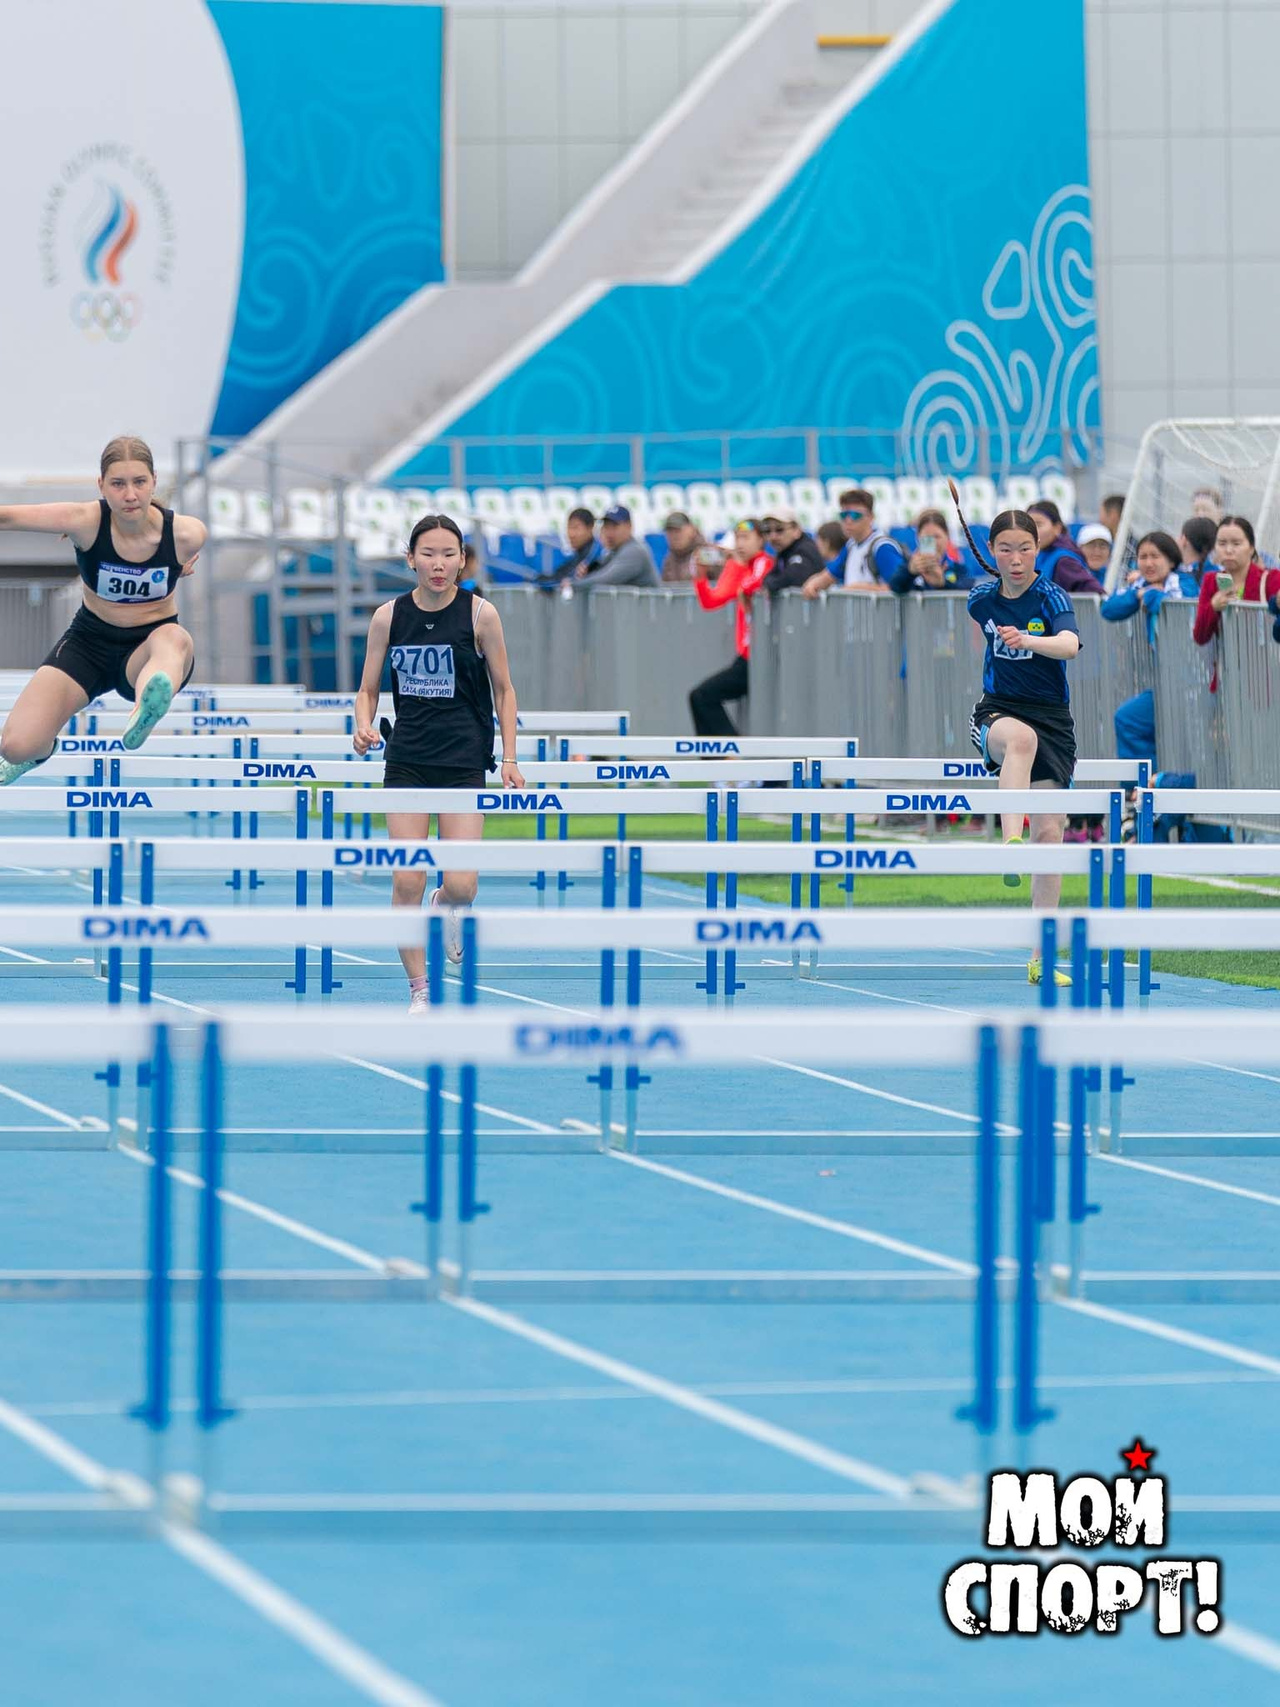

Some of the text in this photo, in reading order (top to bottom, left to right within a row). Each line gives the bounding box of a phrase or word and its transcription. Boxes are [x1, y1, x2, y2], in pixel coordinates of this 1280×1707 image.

[108, 577, 150, 598] 304
[393, 646, 453, 675] 2701
[194, 716, 250, 728] DIMA
[61, 740, 125, 752] DIMA
[675, 740, 740, 754] DIMA
[243, 763, 317, 779] DIMA
[596, 766, 670, 780] DIMA
[943, 763, 998, 778] DIM
[66, 790, 152, 807] DIMA
[477, 793, 563, 810] DIMA
[886, 794, 971, 811] DIMA
[333, 846, 438, 868] DIMA
[814, 850, 917, 869] DIMA
[82, 917, 209, 939] DIMA
[696, 920, 822, 942] DIMA
[515, 1024, 682, 1053] DIMA
